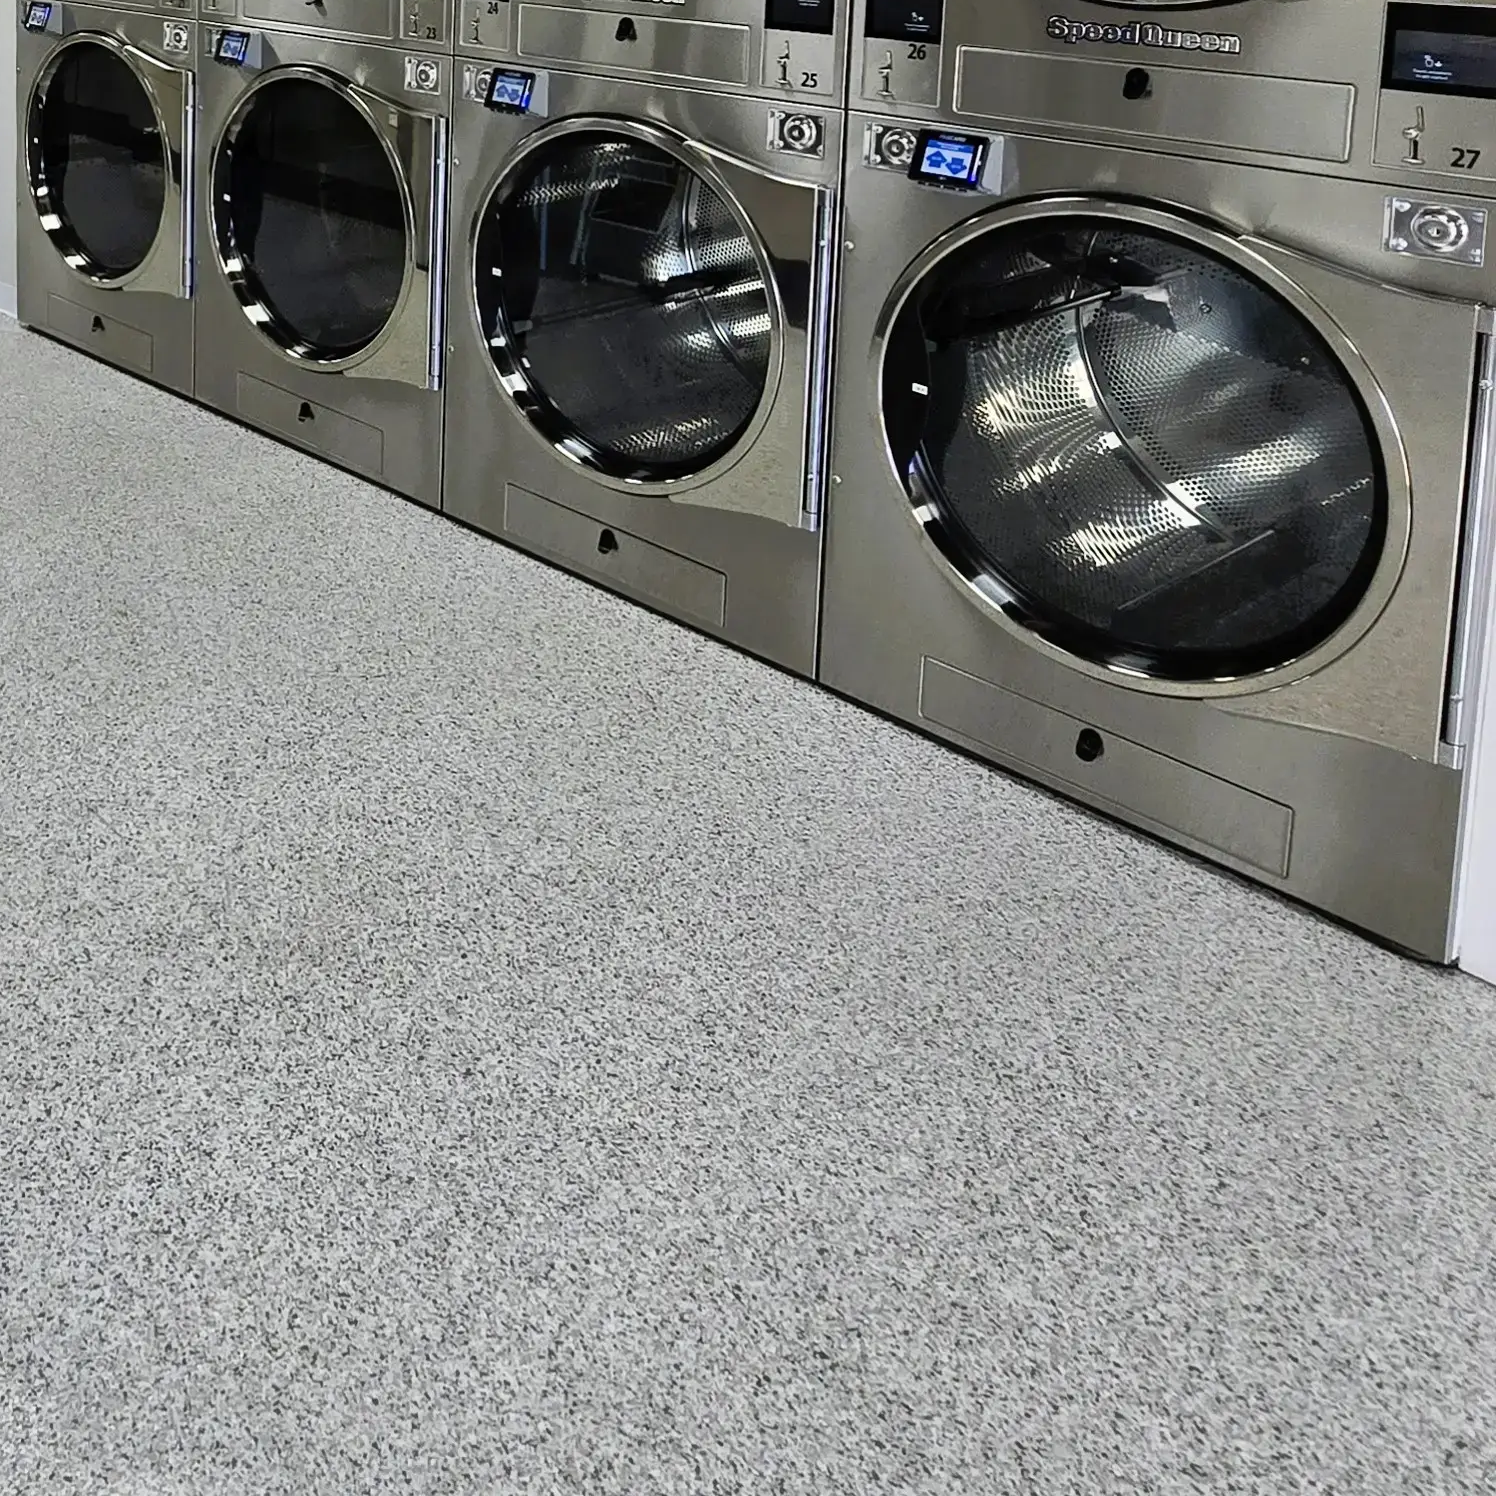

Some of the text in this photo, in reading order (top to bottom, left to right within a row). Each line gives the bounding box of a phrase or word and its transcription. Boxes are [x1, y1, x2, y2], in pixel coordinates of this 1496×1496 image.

[487, 2, 499, 15] 24
[426, 27, 436, 40] 23
[1047, 15, 1242, 55] Speed Queen
[907, 43, 927, 60] 26
[801, 72, 818, 88] 25
[1450, 147, 1481, 169] 27
